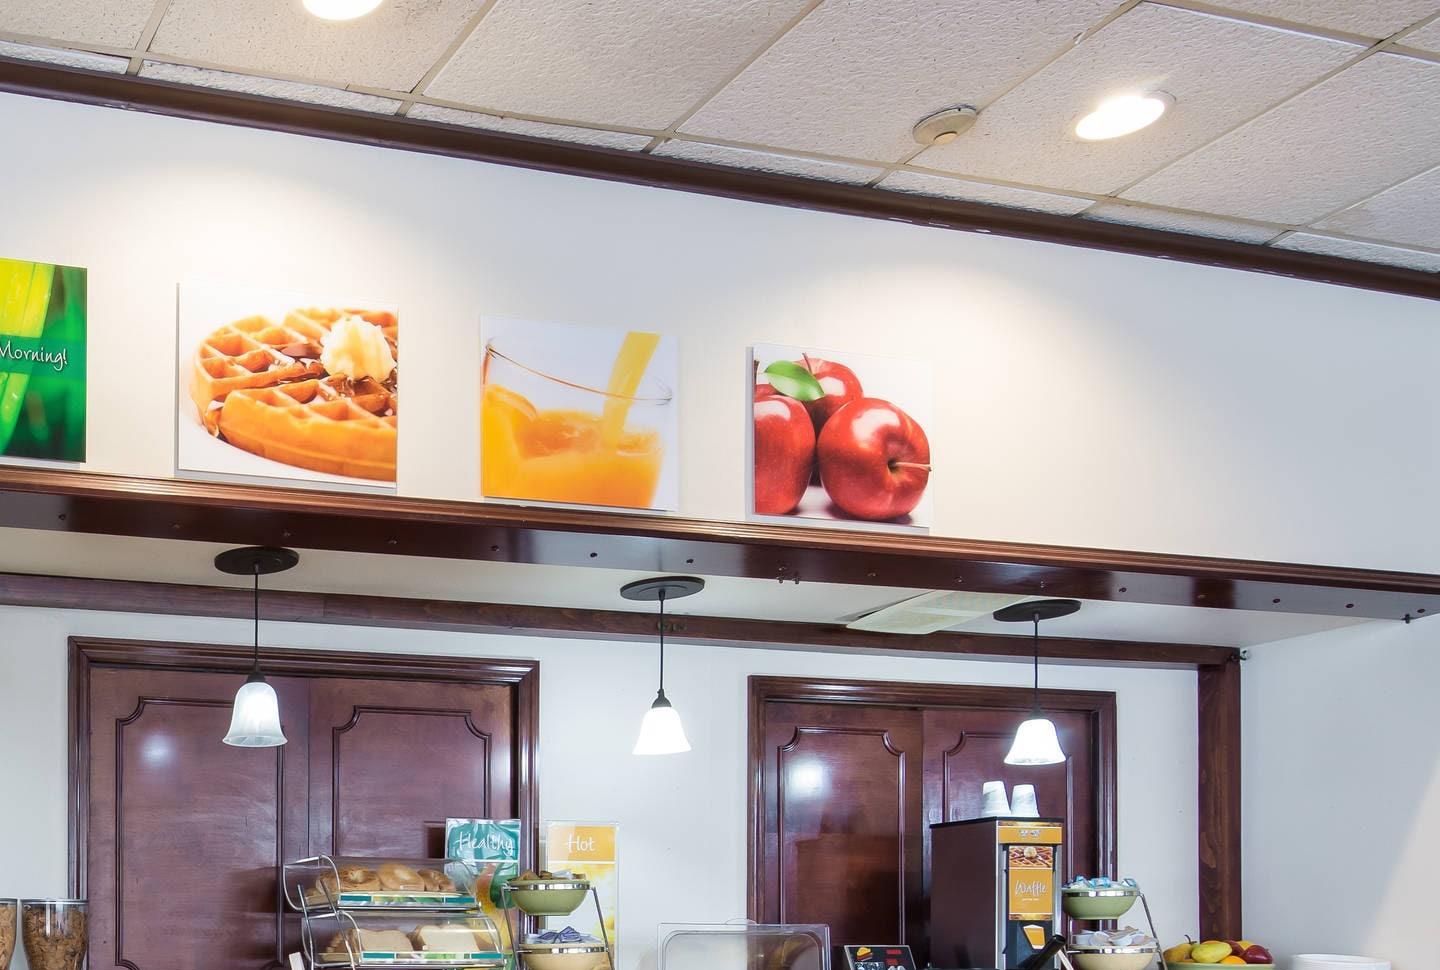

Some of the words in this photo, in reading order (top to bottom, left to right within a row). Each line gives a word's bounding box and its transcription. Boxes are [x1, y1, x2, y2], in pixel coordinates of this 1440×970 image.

[454, 831, 515, 857] Healthy
[566, 832, 596, 853] Hot
[1015, 880, 1048, 897] Waffle
